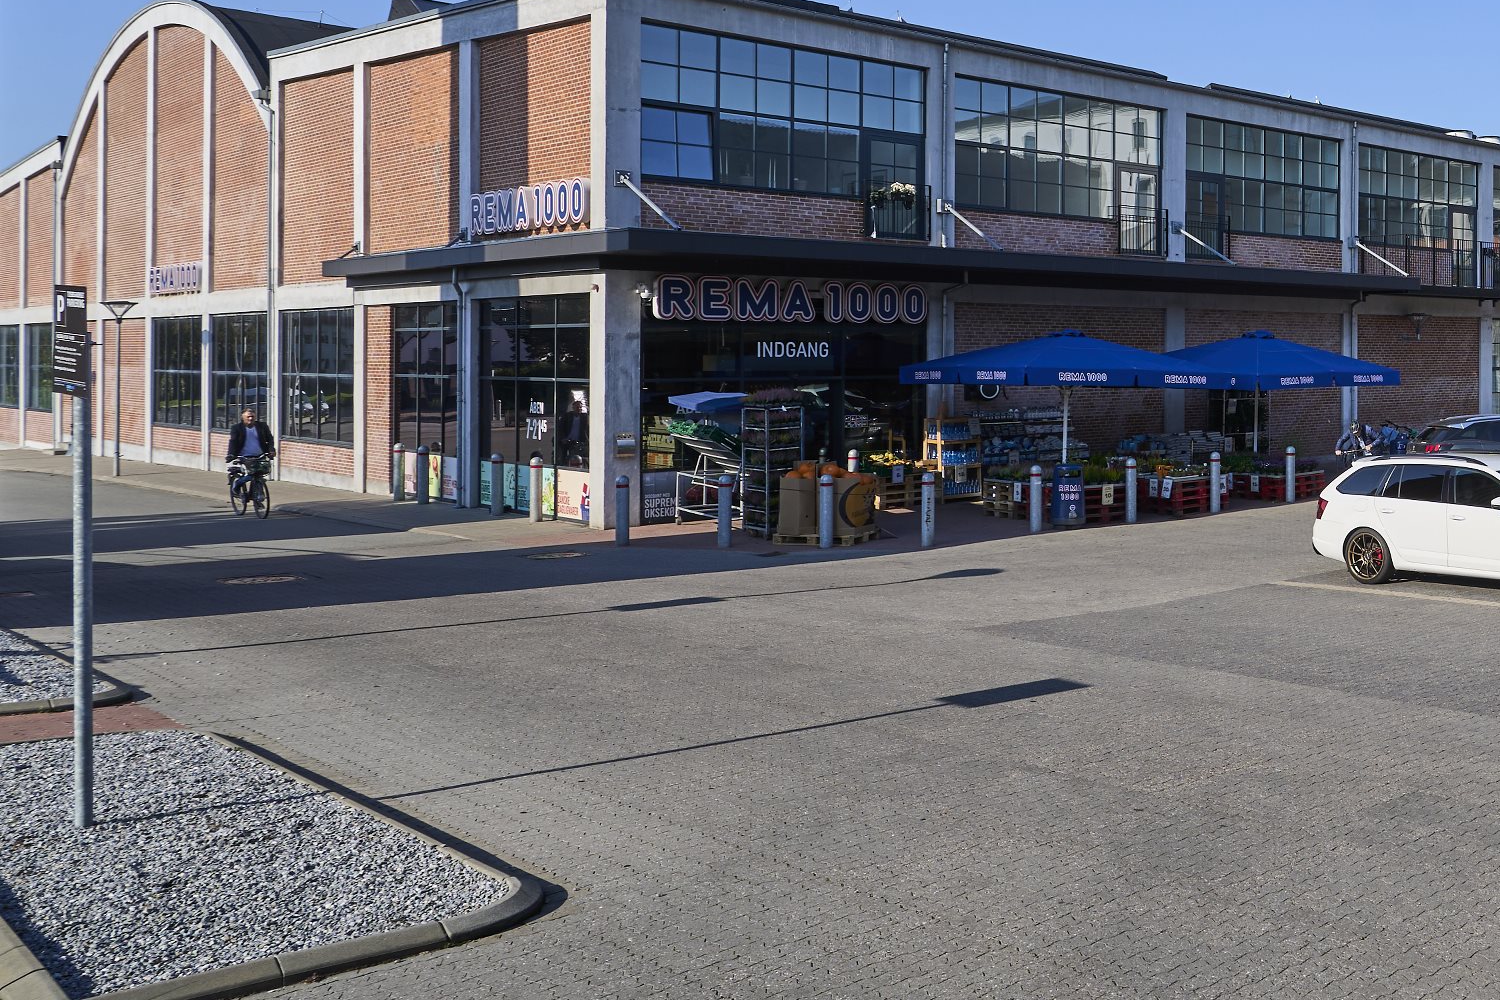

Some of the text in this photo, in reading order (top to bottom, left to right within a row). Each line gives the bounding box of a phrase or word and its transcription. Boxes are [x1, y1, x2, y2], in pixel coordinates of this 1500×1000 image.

[470, 177, 585, 236] REMA 1000
[149, 262, 198, 294] REMA 1000
[656, 274, 928, 324] REMA 1000
[56, 294, 65, 322] P
[756, 341, 829, 358] INDGANG
[914, 371, 942, 380] REMA 1000
[976, 371, 1007, 380] REMA 1000
[1058, 372, 1108, 382] REMA 1000
[1164, 374, 1207, 385] REMA 1000
[1280, 375, 1315, 386] REMA 1000
[1353, 374, 1383, 383] REMA 1000
[529, 397, 545, 415] ÅBEN
[1058, 484, 1081, 492] REMA
[1060, 492, 1080, 501] 1000
